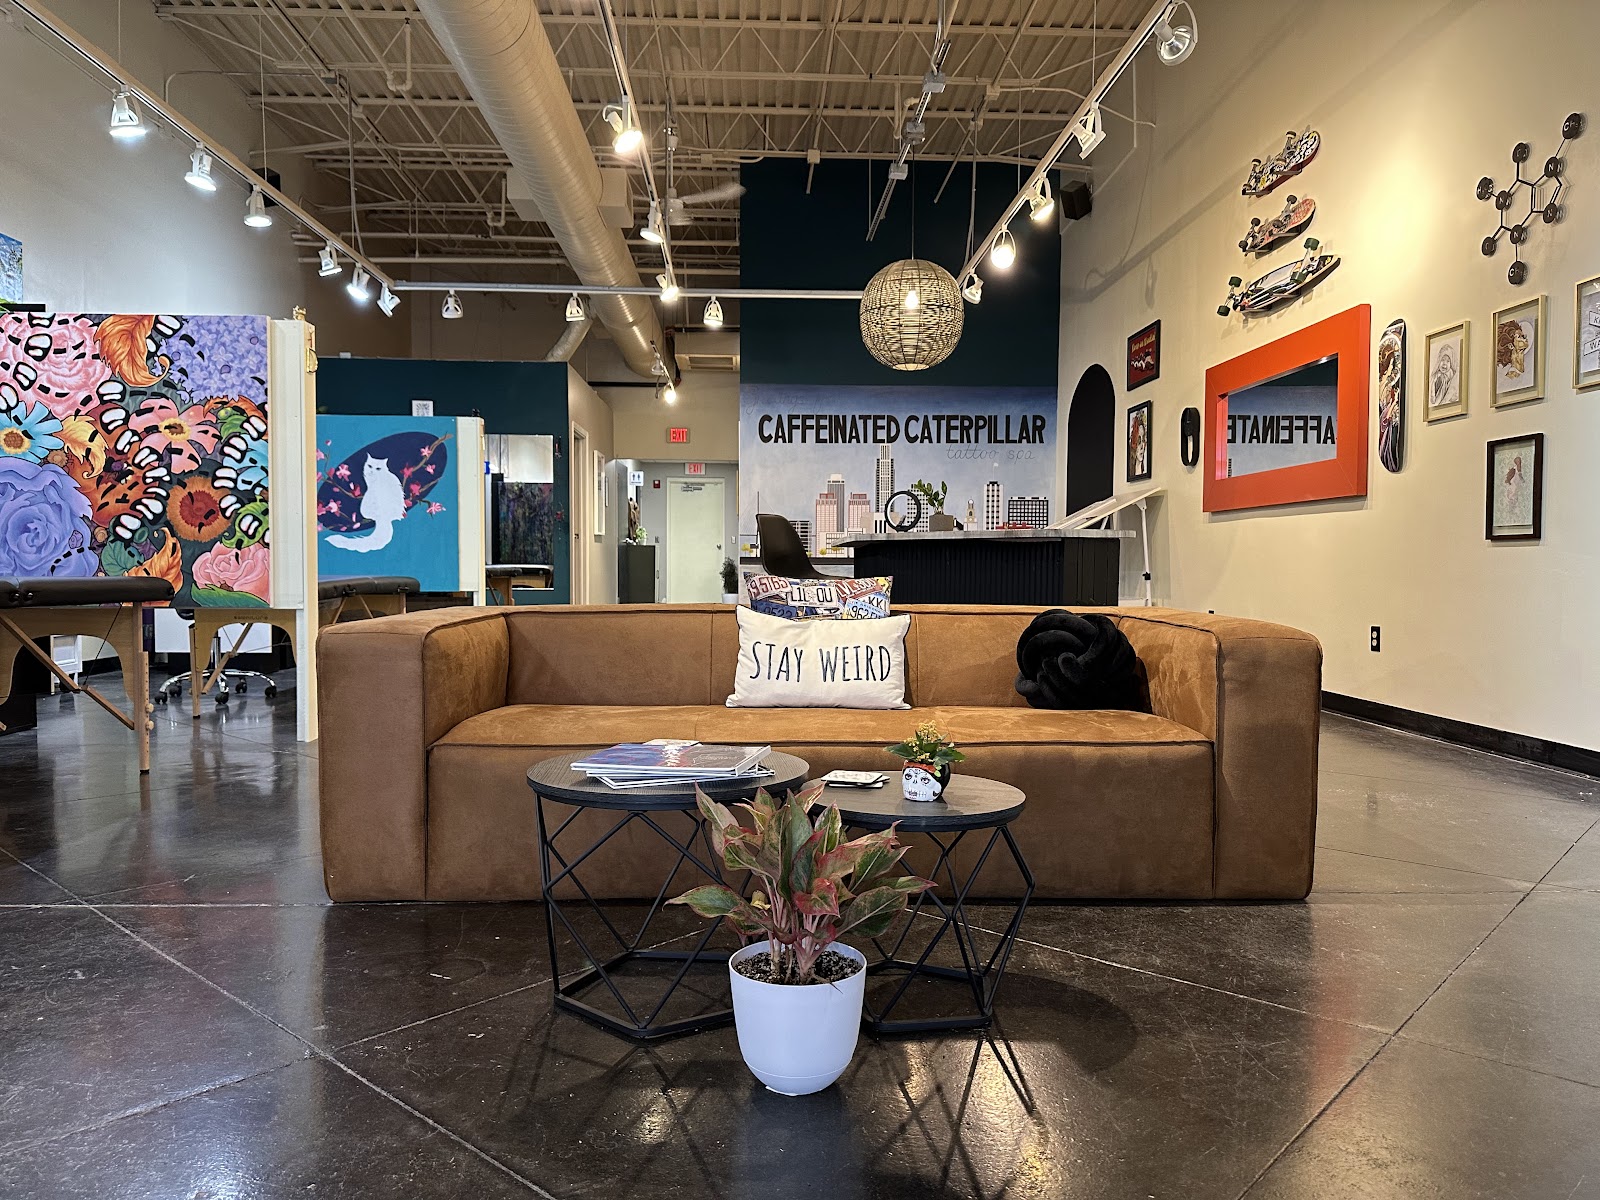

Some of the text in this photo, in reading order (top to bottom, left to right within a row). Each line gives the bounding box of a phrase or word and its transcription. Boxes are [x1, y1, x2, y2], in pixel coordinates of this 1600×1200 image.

[670, 428, 688, 443] EXIT
[758, 414, 1046, 444] CAFFEINATED CATERPILLAR
[946, 444, 1036, 465] tattoo spa
[688, 463, 703, 474] EXIT
[750, 641, 891, 682] STAY WEIRD
